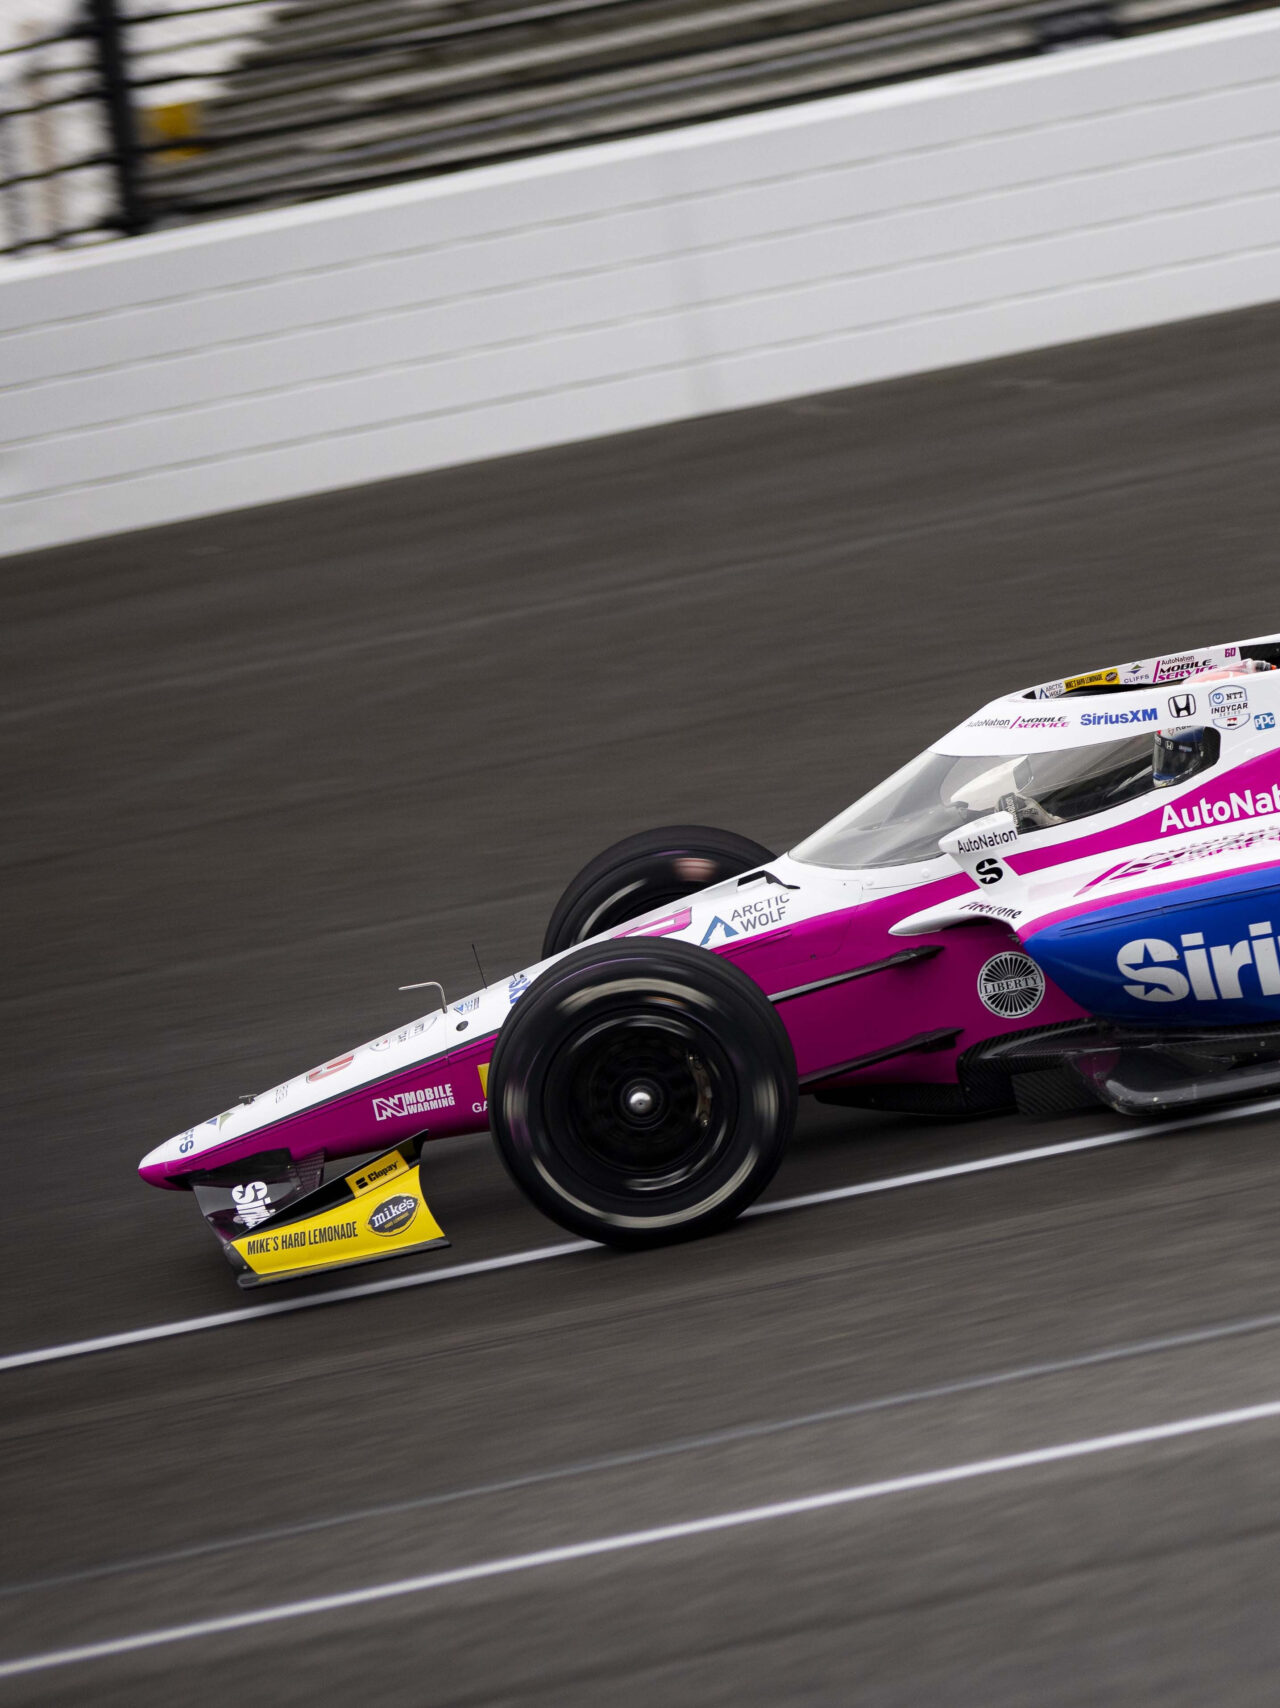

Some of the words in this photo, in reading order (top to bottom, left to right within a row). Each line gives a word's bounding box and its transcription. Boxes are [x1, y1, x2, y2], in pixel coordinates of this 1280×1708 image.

[1225, 647, 1236, 658] 60
[1160, 659, 1212, 674] MOBILE
[1124, 674, 1150, 684] CLIFFS
[1226, 691, 1243, 701] NTT
[1080, 707, 1158, 726] SiriusXM
[1211, 702, 1248, 715] INDYCAR
[1255, 714, 1275, 730] PPG
[957, 830, 1018, 854] AutoNation
[731, 892, 790, 922] ARCTIC
[958, 901, 1022, 919] Firestone
[740, 906, 787, 932] WOLF
[983, 975, 1038, 995] LIBERTY
[404, 1083, 454, 1105] MOBILE
[407, 1096, 456, 1115] WARMING
[367, 1160, 399, 1182] Clopay
[372, 1199, 415, 1227] mike's
[247, 1236, 279, 1256] MIKE'S
[281, 1231, 306, 1250] HARD
[308, 1220, 359, 1245] LEMONADE
